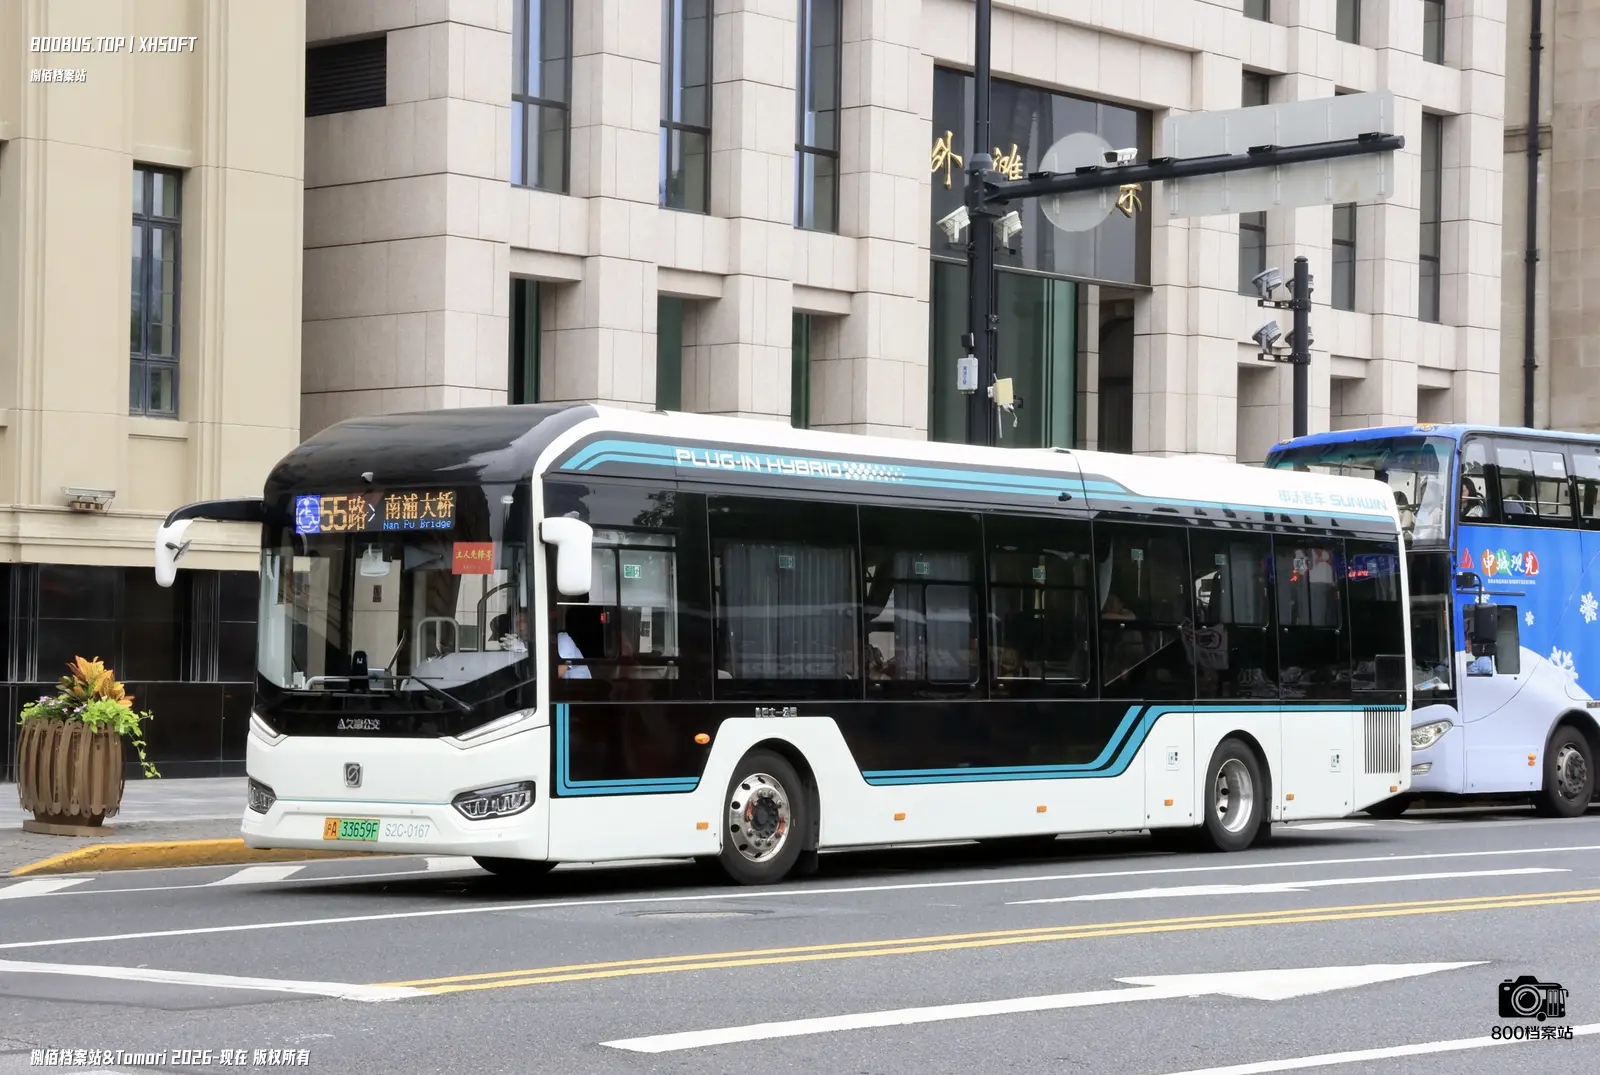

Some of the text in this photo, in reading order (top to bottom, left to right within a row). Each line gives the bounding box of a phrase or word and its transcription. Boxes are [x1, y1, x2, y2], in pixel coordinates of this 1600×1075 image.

[675, 448, 842, 477] PLUG-IN HYBRID
[320, 496, 367, 531] 55路
[384, 491, 454, 520] 南浦大桥
[1329, 493, 1388, 511] SUNWIN
[383, 519, 452, 530] Nan Pu Bridge
[455, 548, 492, 561] 工人先锋号
[1482, 548, 1540, 578] 申城观光
[385, 823, 431, 838] S2C-0167
